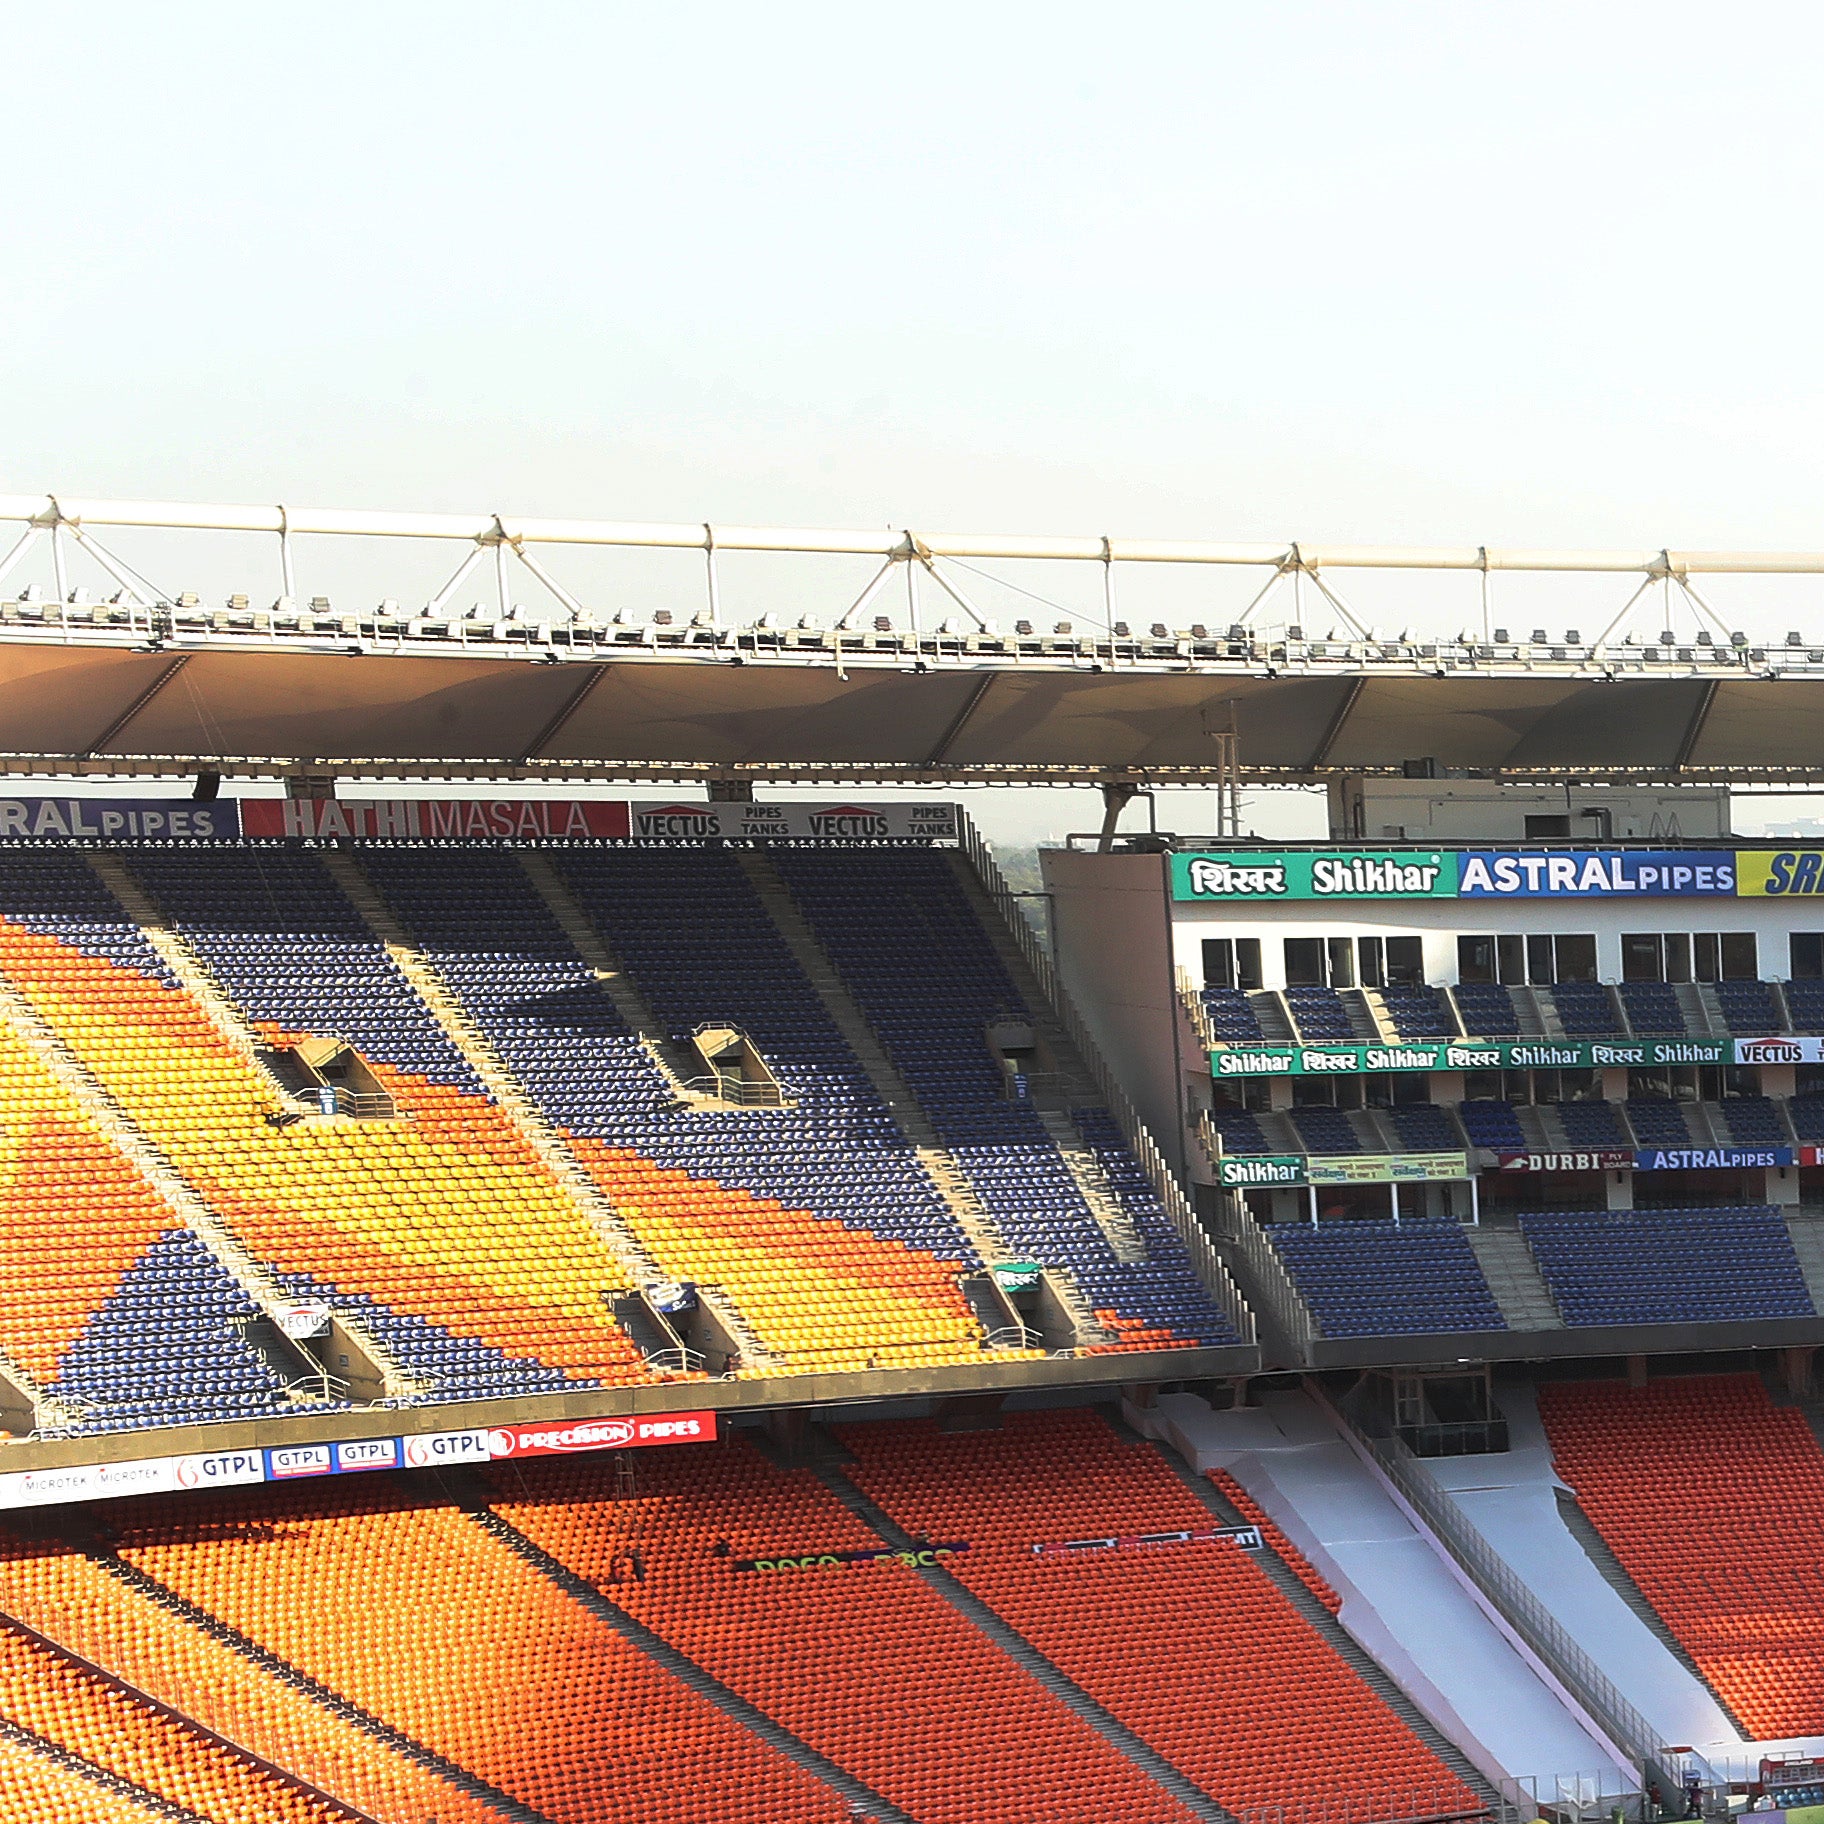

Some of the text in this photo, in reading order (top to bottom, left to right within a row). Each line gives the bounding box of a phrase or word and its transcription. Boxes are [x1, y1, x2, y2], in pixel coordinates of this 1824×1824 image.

[282, 799, 589, 837] HATHI MASALA
[745, 807, 781, 818] PIPES
[912, 807, 947, 818] PIPES
[103, 810, 213, 837] PIPES
[638, 815, 720, 836] VECTUS
[740, 823, 789, 834] TANKS
[808, 815, 889, 836] VECTUS
[908, 823, 953, 834] TANKS
[1190, 861, 1286, 893] शिखर
[1312, 859, 1439, 893] Shikhar
[1460, 857, 1734, 891] ASTRAL PIPES
[1218, 1051, 1292, 1074] Shikhar
[1302, 1053, 1357, 1071] शिखर
[1510, 1044, 1582, 1065] Shikhar
[1740, 1045, 1802, 1062] VECTUS
[1529, 1154, 1601, 1170] DURBI
[1653, 1151, 1774, 1168] ASTRAL PIPES
[1223, 1161, 1299, 1184] Shikhar
[519, 1420, 701, 1450] PRECISION PIPES
[345, 1444, 389, 1459] GTPL
[432, 1436, 485, 1454] GTPL
[203, 1458, 259, 1476] GTPL
[278, 1451, 322, 1466] GTPL
[25, 1477, 87, 1490] MICROTEK
[100, 1470, 159, 1482] MICROTEK
